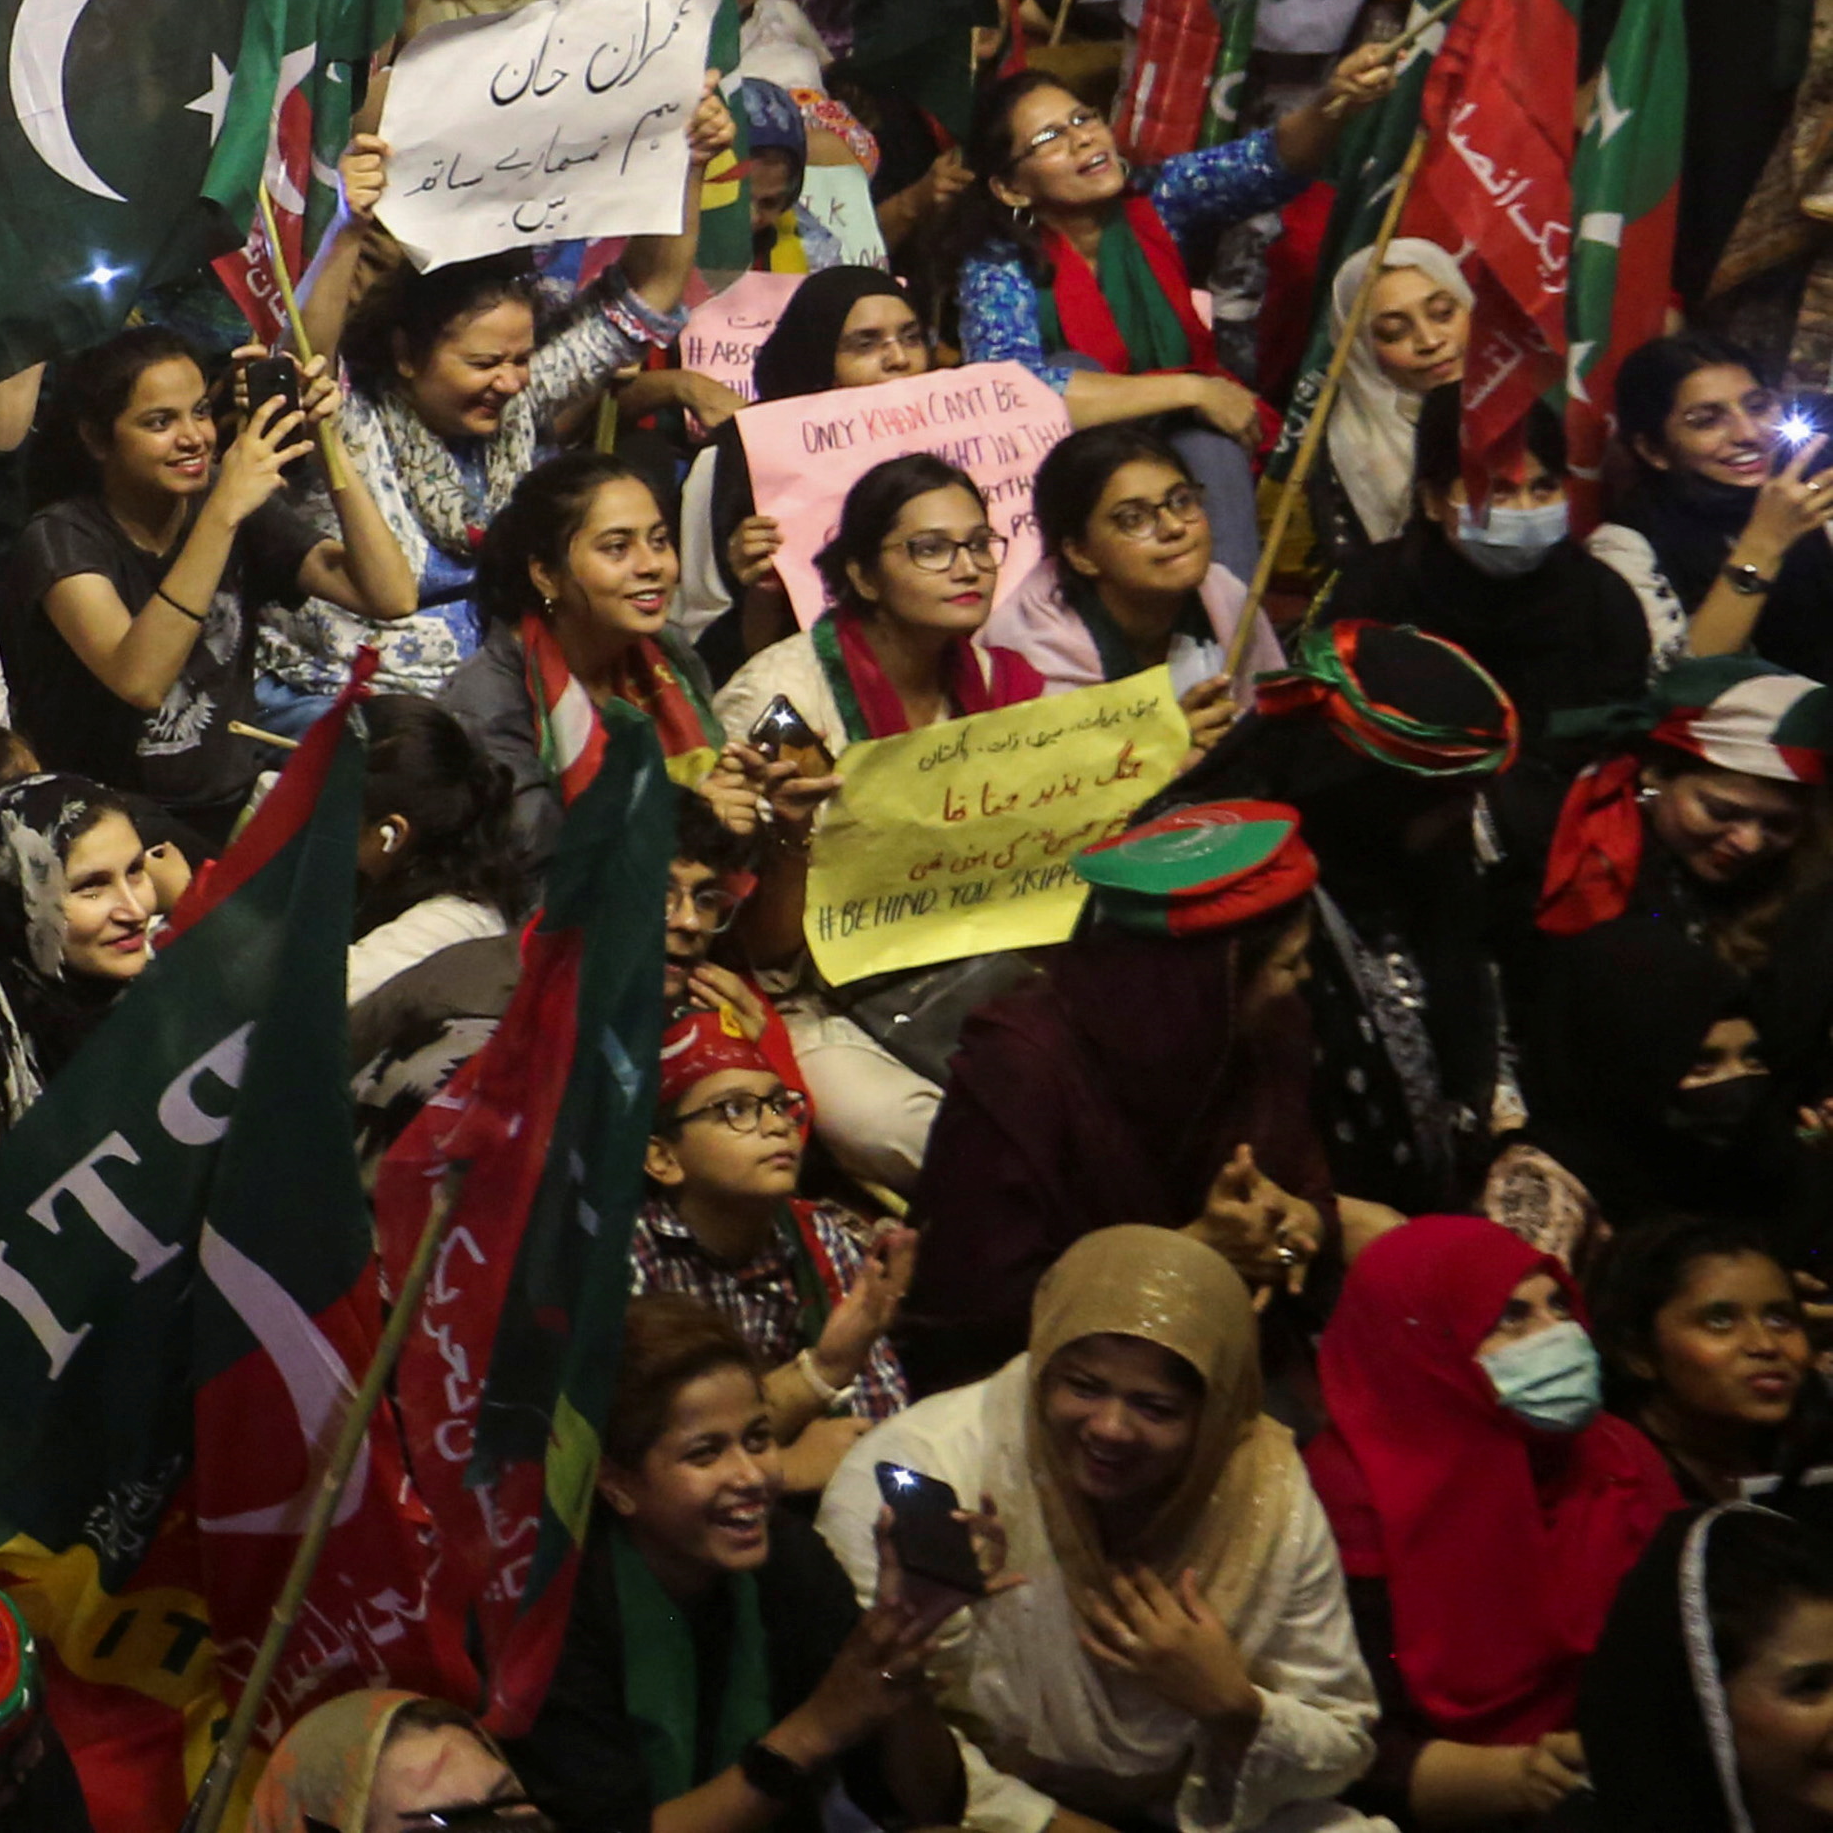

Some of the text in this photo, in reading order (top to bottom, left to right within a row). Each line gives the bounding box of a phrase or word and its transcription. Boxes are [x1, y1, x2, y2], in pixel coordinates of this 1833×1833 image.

[490, 34, 569, 107] خان
[801, 417, 856, 455] ONLY
[859, 401, 928, 442] KHAN
[991, 379, 1029, 413] BE
